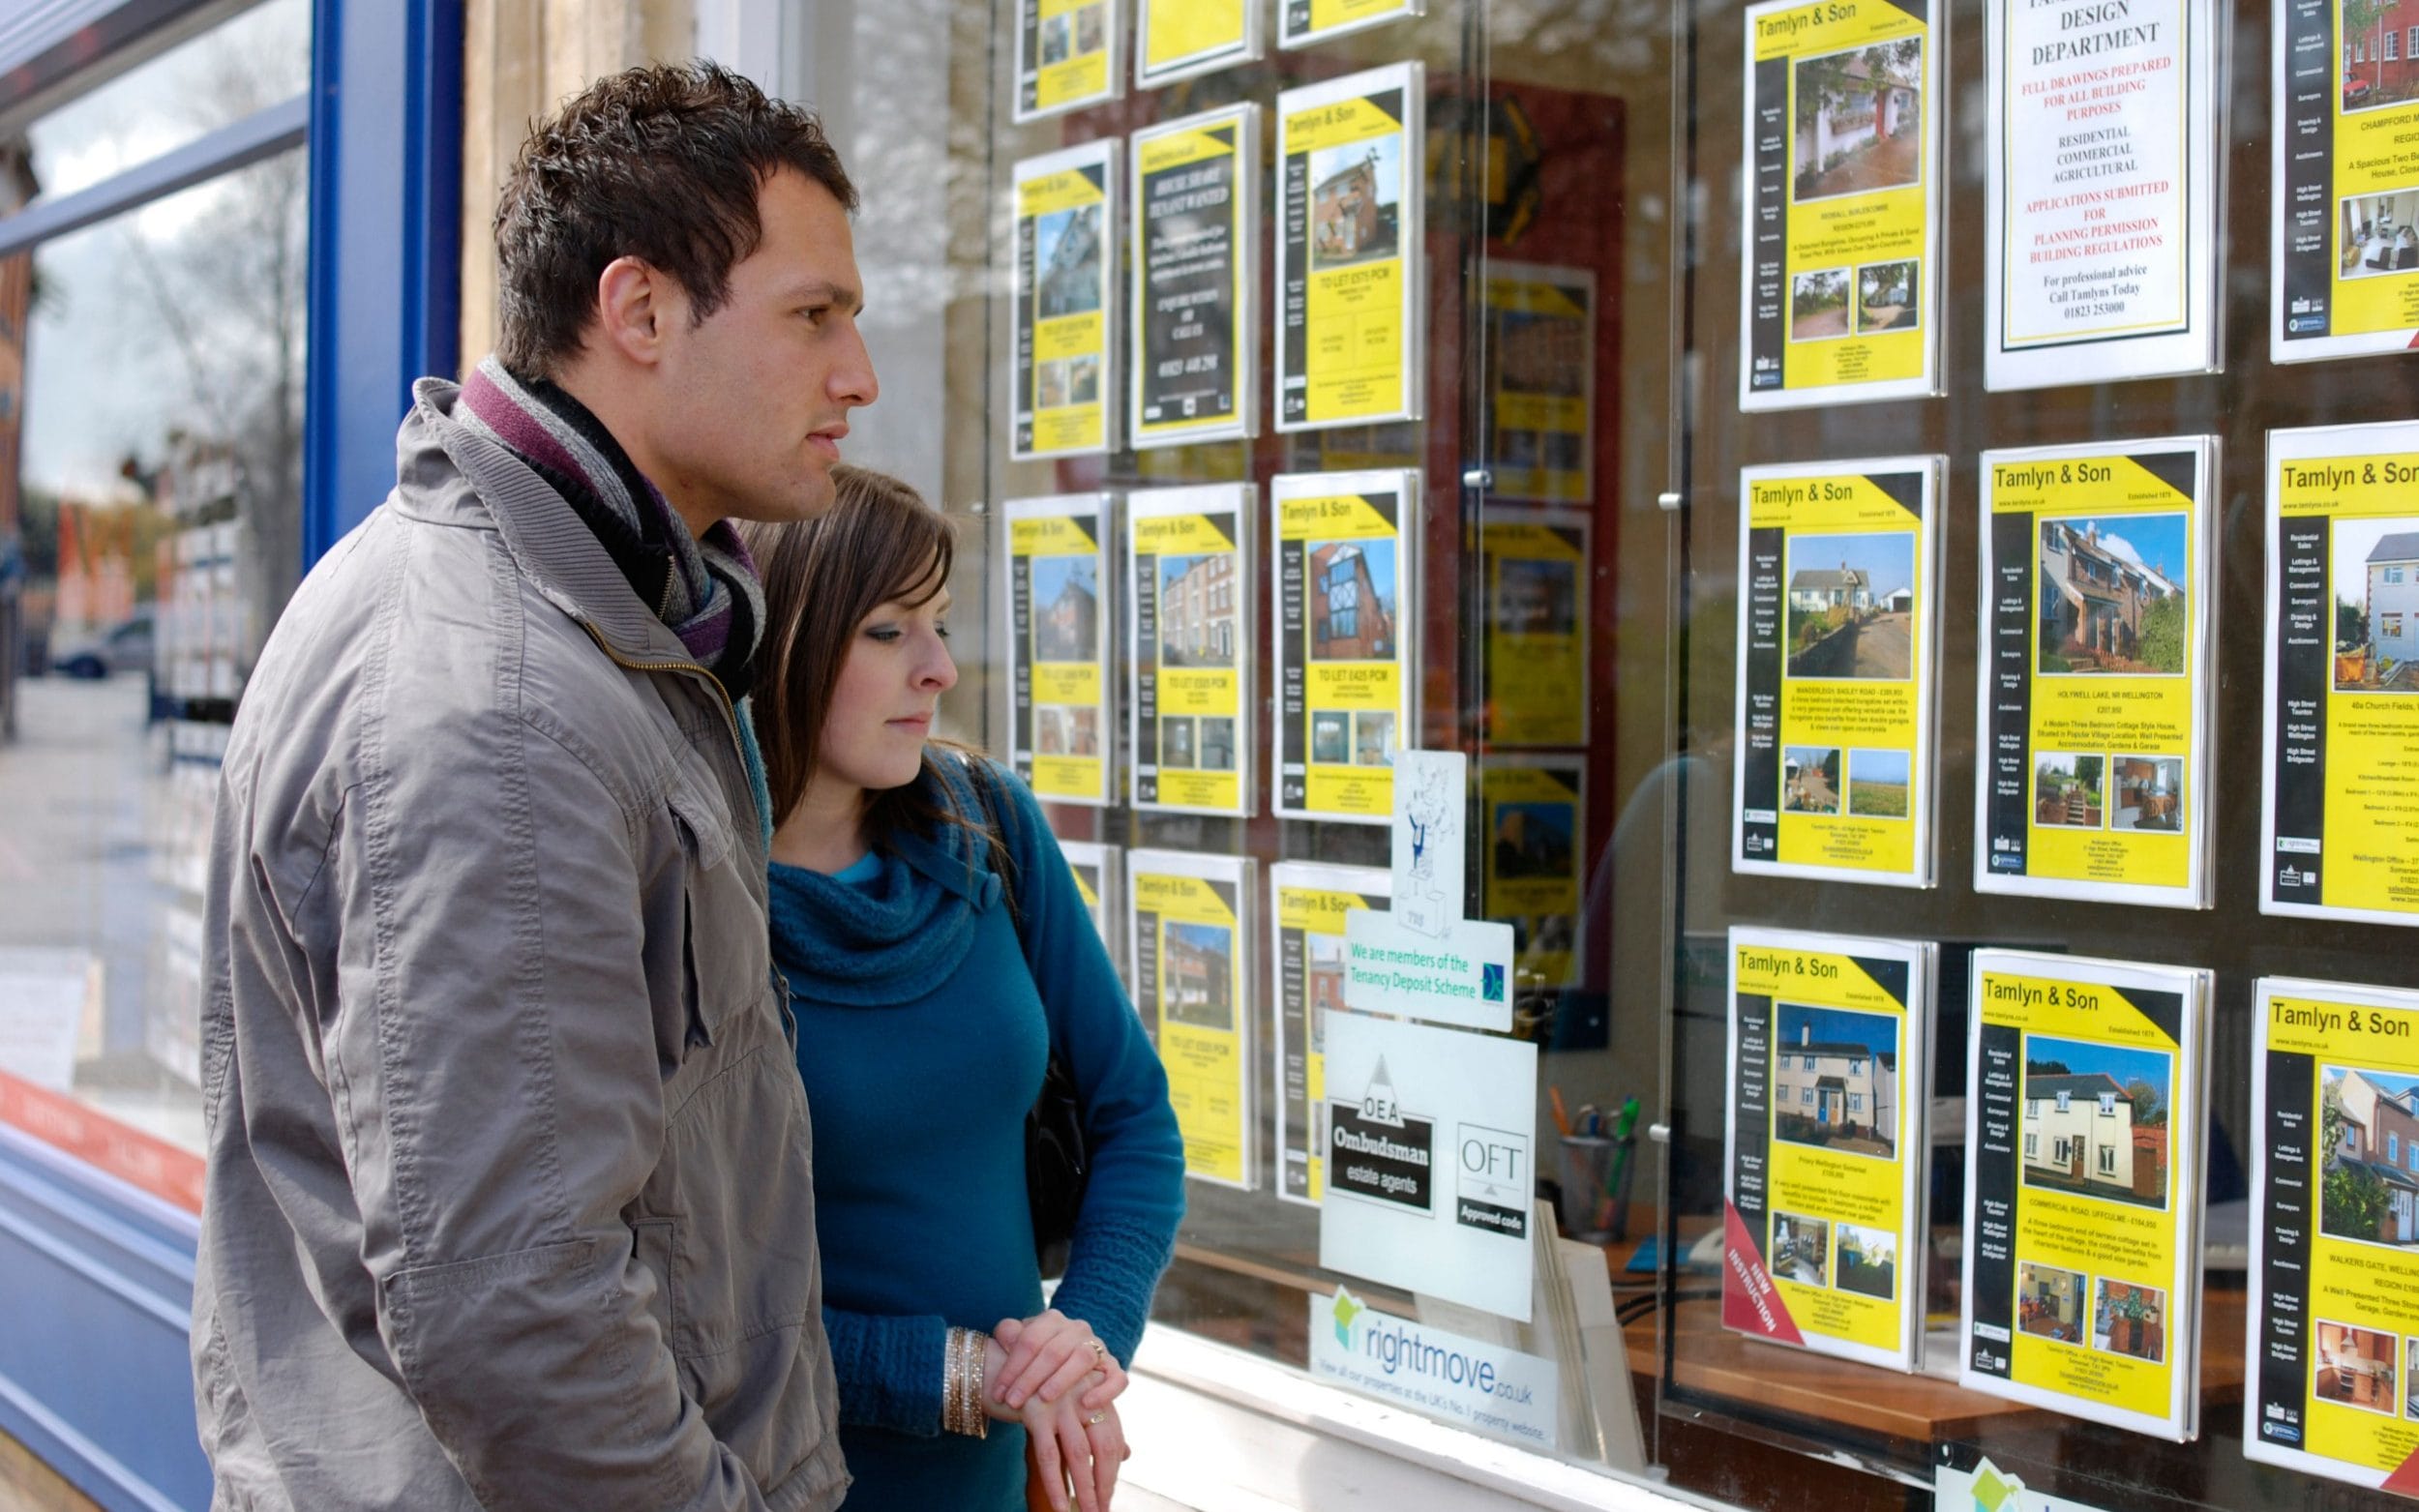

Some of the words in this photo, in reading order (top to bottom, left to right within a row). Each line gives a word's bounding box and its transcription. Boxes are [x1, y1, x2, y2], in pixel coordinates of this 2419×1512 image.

[1757, 15, 1808, 37] Tamlyn
[1812, 8, 1823, 25] &
[1828, 4, 1856, 22] Son
[2061, 0, 2130, 30] DESIGN
[2033, 23, 2160, 65] DEPARTMENT
[2022, 80, 2047, 96] FULL
[2050, 70, 2108, 90] DRAWINGS
[2111, 57, 2171, 77] PREPARED
[2044, 94, 2065, 108] FOR
[2069, 90, 2088, 104] ALL
[2092, 79, 2145, 100] BUILDING
[2067, 103, 2121, 121] PURPOSES
[2361, 114, 2411, 131] CHAMPFORD
[2059, 126, 2132, 148] RESIDENTIAL
[2057, 143, 2132, 165] COMMERCIAL
[2356, 158, 2391, 170] Spacious
[2055, 160, 2137, 183] AGRICULTURAL
[2027, 193, 2102, 213] APPLICATIONS
[2105, 181, 2168, 200] SUBMITTED
[2084, 208, 2105, 222] FOR
[2035, 227, 2088, 246] PLANNING
[2091, 218, 2158, 237] PERMISSION
[2030, 247, 2081, 263] BUILDING
[2084, 235, 2163, 255] REGULATIONS
[2044, 276, 2060, 287] For
[2062, 267, 2116, 287] professional
[2118, 264, 2147, 278] advice
[2049, 291, 2069, 303] Call
[2072, 287, 2109, 301] Tamlyns
[2112, 282, 2139, 296] Today
[2064, 305, 2091, 318] 01823
[2094, 302, 2125, 315] 253000
[1995, 467, 2054, 490] Tamlyn
[2061, 464, 2072, 484] &
[2078, 463, 2110, 483] Son
[2285, 465, 2355, 491] Tamlyn
[2362, 463, 2376, 485] &
[1752, 486, 1804, 507] Tamlyn
[1808, 484, 1819, 501] &
[1824, 483, 1852, 501] Son
[1281, 504, 1318, 520] Tamlyn
[1320, 503, 1328, 518] &
[1330, 501, 1351, 518] Son
[1319, 669, 1329, 681] TO
[1332, 669, 1347, 681] LET
[2365, 701, 2391, 710] Church
[2067, 730, 2090, 739] Popular
[2091, 730, 2110, 740] Village
[2089, 721, 2115, 729] Bedroom
[2117, 722, 2139, 730] Cottage
[2140, 722, 2155, 731] Style
[1280, 891, 1317, 911] Tamlyn
[1320, 896, 1328, 911] &
[1352, 944, 1367, 960] We
[1369, 948, 1386, 962] are
[1387, 950, 1435, 968] members
[1437, 954, 1450, 969] of
[1449, 956, 1469, 972] the
[1739, 951, 1790, 977] Tamlyn
[1795, 957, 1805, 974] &
[1810, 958, 1837, 978] Son
[1351, 965, 1391, 991] Tenancy
[1392, 972, 1433, 993] Deposit
[1434, 978, 1476, 998] Scheme
[1985, 978, 2043, 1006] Tamlyn
[2048, 986, 2060, 1005] &
[2066, 988, 2098, 1011] Son
[2272, 1002, 2341, 1033] Tamlyn
[2348, 1010, 2362, 1031] &
[2370, 1012, 2409, 1037] Son
[2276, 1039, 2329, 1050] www.tamlyns.co.uk
[1364, 1097, 1399, 1123] OEA
[1334, 1126, 1429, 1166] Ombudsman
[1462, 1139, 1523, 1180] OFT
[1347, 1166, 1380, 1185] estate
[1381, 1173, 1418, 1194] agents
[1461, 1204, 1501, 1225] Approved
[1501, 1217, 1522, 1230] code
[2029, 1199, 2068, 1212] COMMERCIAL
[2092, 1210, 2125, 1223] UFFCULME
[2330, 1255, 2364, 1267] WALKERS
[1728, 1248, 1777, 1332] INSTRUCTION
[1749, 1261, 1771, 1294] NEW
[2374, 1278, 2403, 1290] REGION
[2329, 1287, 2344, 1295] Well
[2345, 1289, 2380, 1302] Presented
[2381, 1295, 2401, 1306] Three
[2382, 1307, 2407, 1319] Garden
[1365, 1320, 1533, 1406] rightmove.co.uk
[1321, 1359, 1337, 1373] View
[1339, 1366, 1348, 1377] all
[1349, 1371, 1362, 1381] our
[1363, 1376, 1403, 1395] properties
[1404, 1388, 1413, 1399] at
[1414, 1390, 1427, 1404] the
[1474, 1410, 1509, 1432] property
